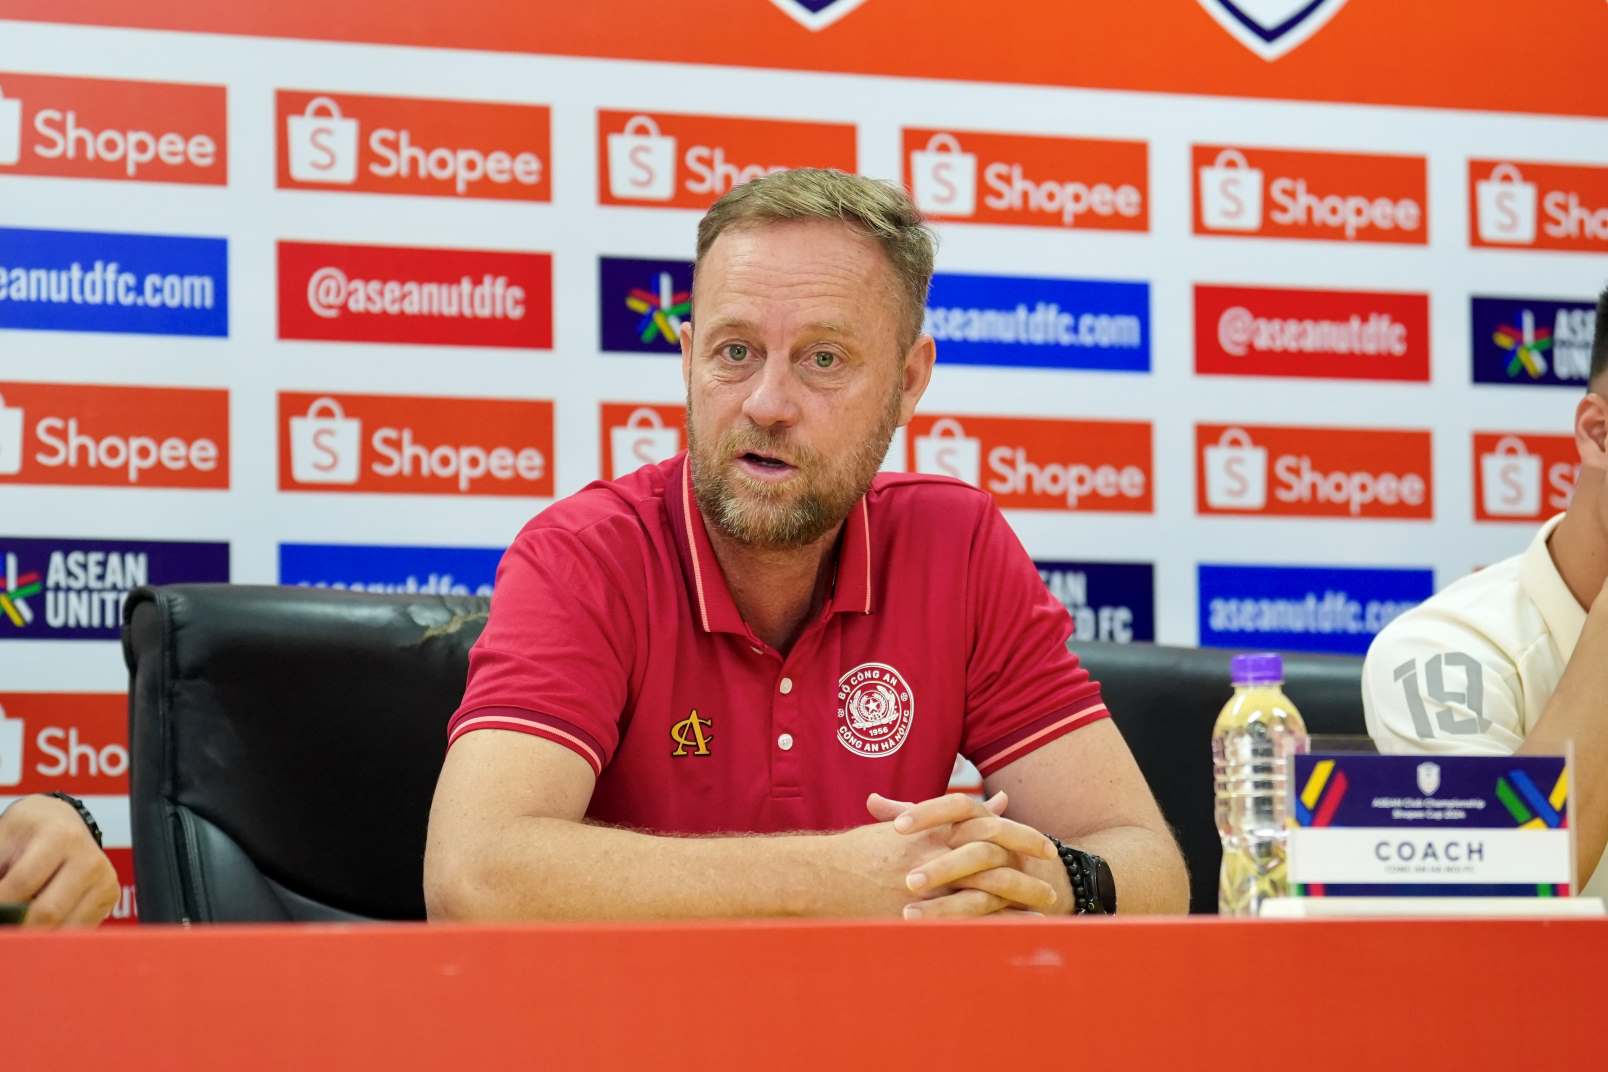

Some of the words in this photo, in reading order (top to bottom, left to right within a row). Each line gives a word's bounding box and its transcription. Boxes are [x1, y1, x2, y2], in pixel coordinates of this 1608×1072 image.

[33, 108, 217, 177] Shopee
[368, 127, 543, 194] Shopee
[684, 145, 790, 195] Sho
[983, 162, 1142, 225] Shopee
[1268, 177, 1421, 242] Shopee
[306, 266, 525, 320] @aseanutdfc
[1216, 305, 1408, 357] @aseanutdfc
[35, 416, 220, 482] Shopee
[370, 427, 545, 492] Shopee
[986, 446, 1146, 509] Shopee
[1274, 454, 1426, 514] Shopee
[46, 550, 149, 590] ASEAN
[1097, 605, 1134, 643] FC
[1209, 589, 1416, 634] aseanutdfc.co
[883, 673, 898, 686] AN
[1393, 651, 1494, 740] 19
[36, 726, 129, 777] Sho
[863, 743, 879, 752] AN
[868, 726, 889, 737] 1956
[1375, 841, 1485, 862] COACH
